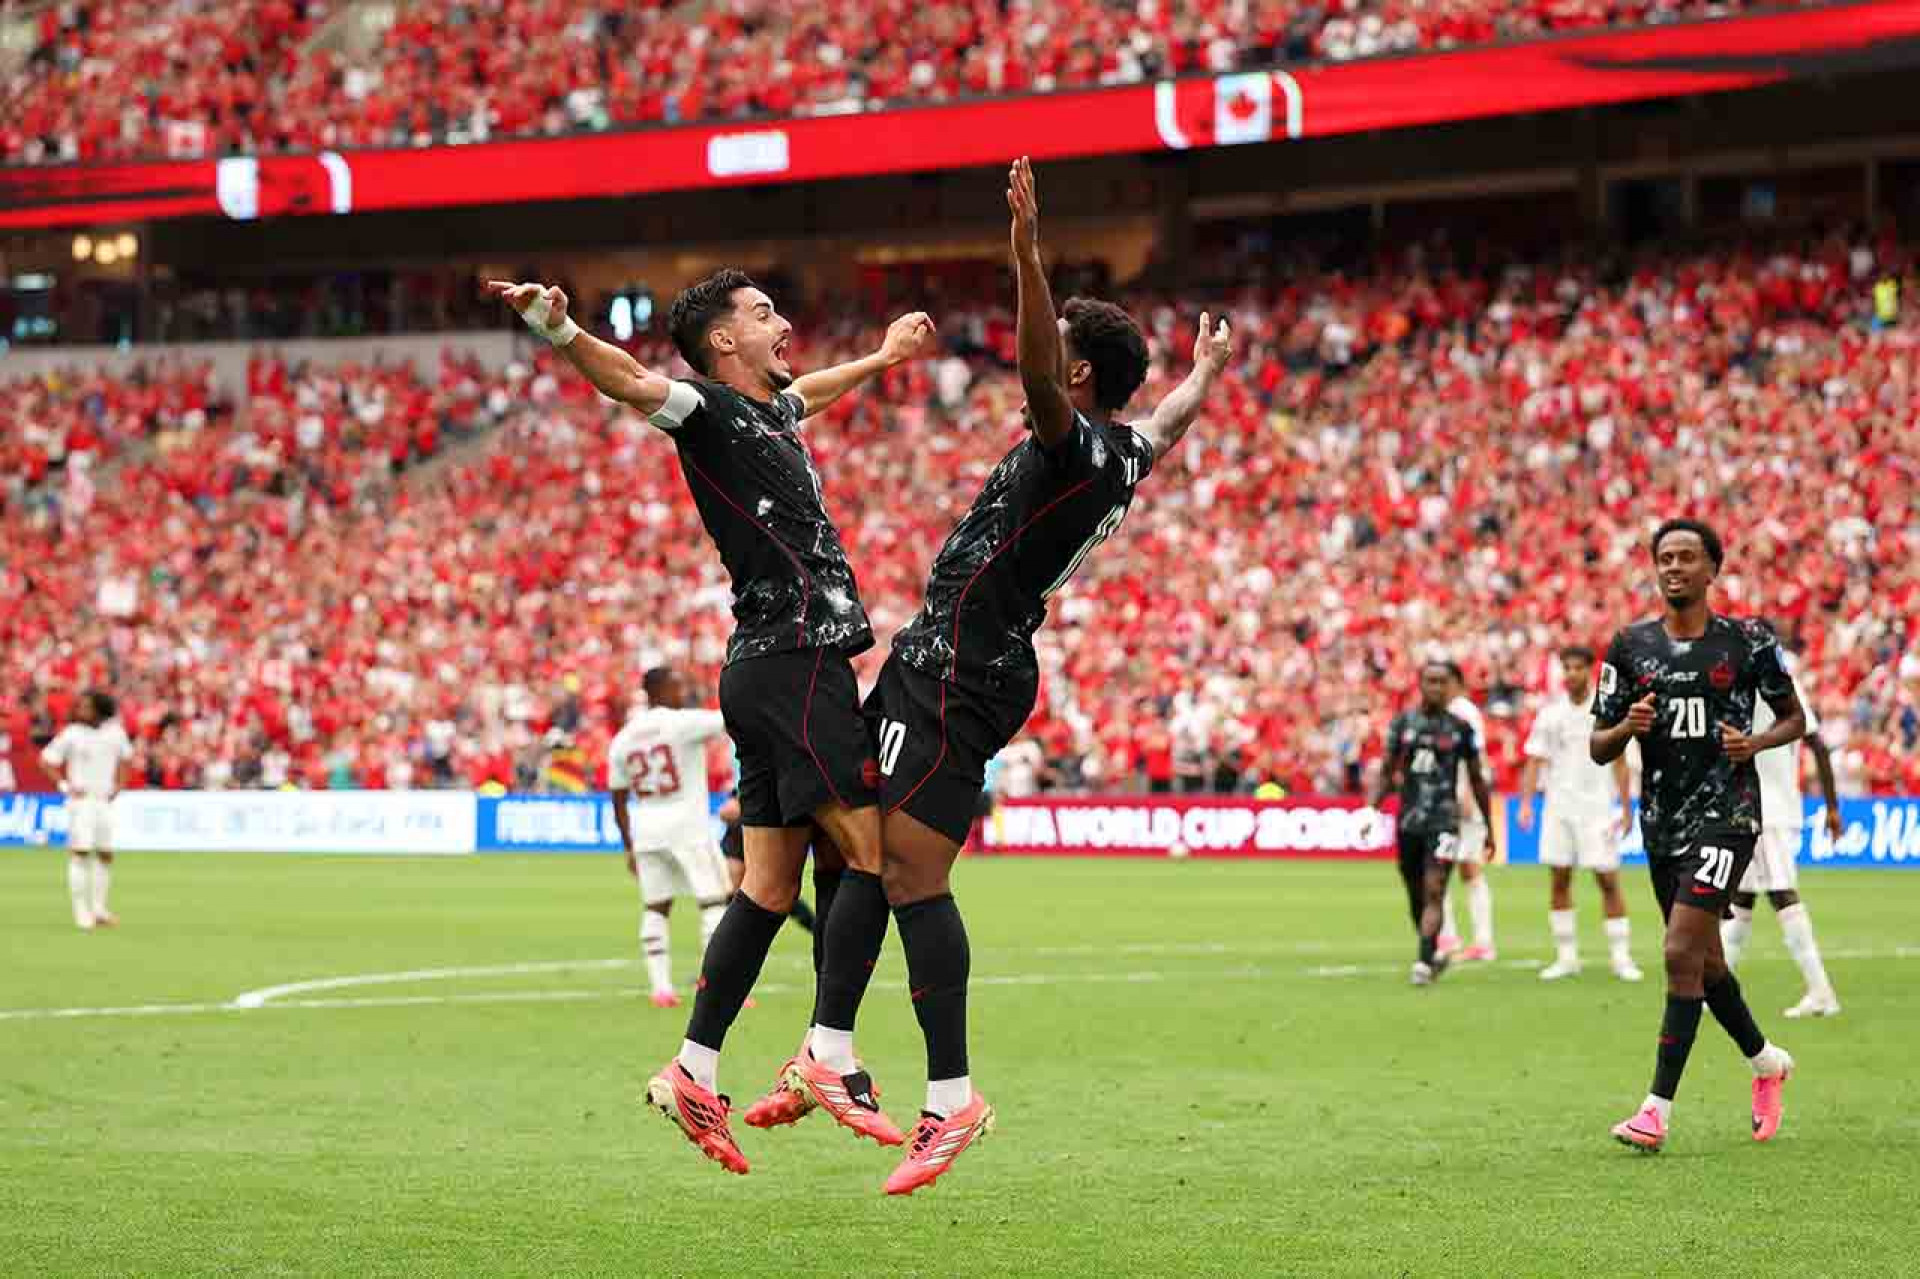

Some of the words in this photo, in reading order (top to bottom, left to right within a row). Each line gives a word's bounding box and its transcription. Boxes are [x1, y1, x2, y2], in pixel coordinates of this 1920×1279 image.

[1668, 697, 1706, 739] 20
[625, 744, 680, 797] 23
[1055, 806, 1181, 847] WORLD
[1184, 806, 1254, 849] CUP
[1694, 846, 1734, 890] 20
